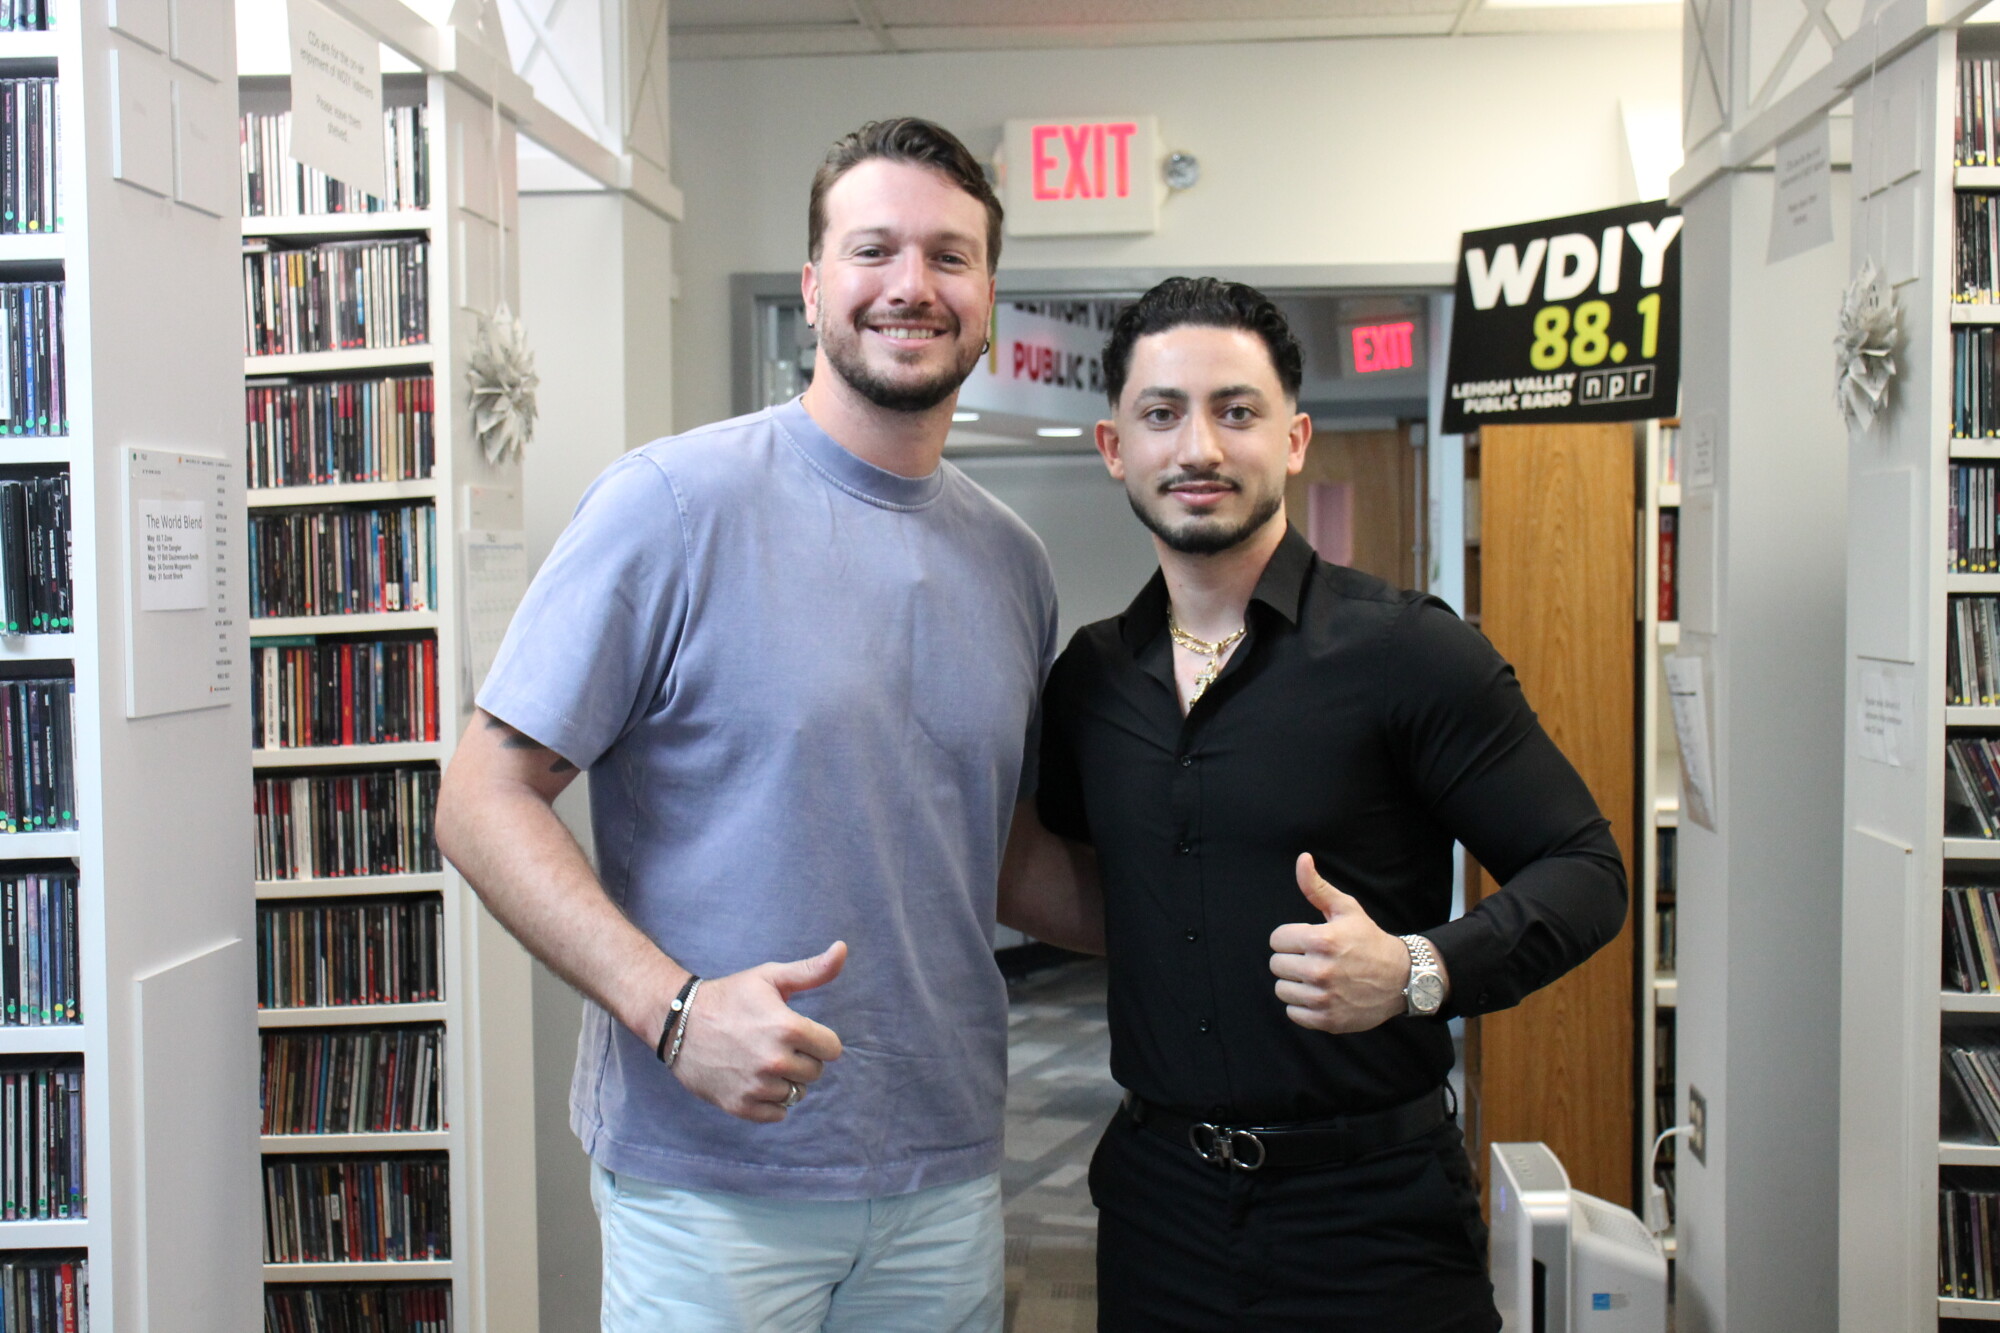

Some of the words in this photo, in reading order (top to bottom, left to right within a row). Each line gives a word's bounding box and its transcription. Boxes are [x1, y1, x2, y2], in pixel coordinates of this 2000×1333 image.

[1031, 122, 1138, 201] EXIT
[1464, 215, 1684, 311] WDIY
[1529, 292, 1661, 372] 88.1
[1352, 321, 1415, 373] EXIT
[1013, 341, 1084, 391] PUBLIC
[1452, 378, 1511, 399] LEHIGH
[1513, 372, 1578, 394] VALLEY
[1585, 371, 1647, 400] npr
[1463, 394, 1519, 415] PUBLIC
[1520, 390, 1573, 410] RADIO
[146, 514, 160, 529] The
[161, 514, 182, 529] World
[183, 515, 203, 529] Blend
[147, 534, 155, 543] May
[147, 544, 155, 553] May
[148, 554, 156, 563] May
[148, 563, 156, 572] May
[148, 573, 157, 582] May
